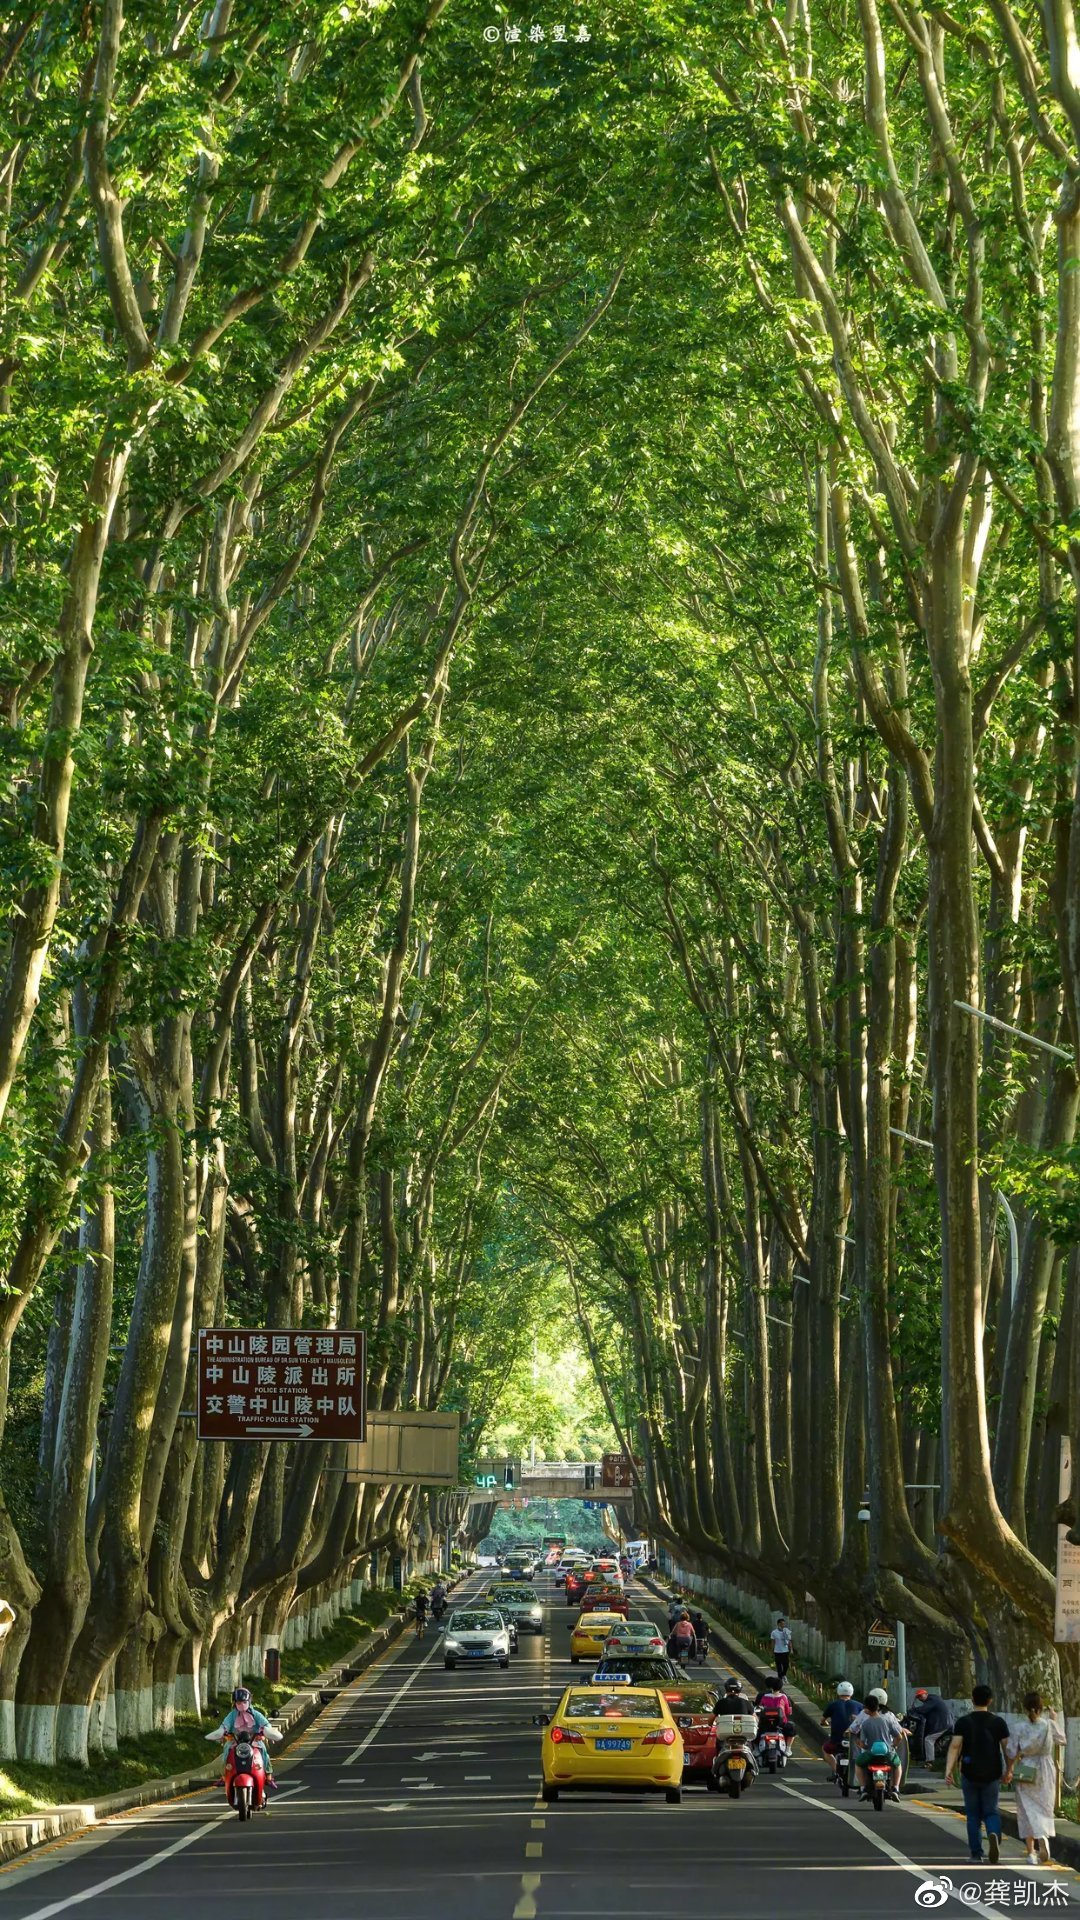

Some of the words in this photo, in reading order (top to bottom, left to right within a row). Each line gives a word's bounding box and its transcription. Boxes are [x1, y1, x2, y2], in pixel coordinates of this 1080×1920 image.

[206, 1334, 357, 1356] 中山陵园管理局
[206, 1364, 356, 1386] 中山陵派出所
[205, 1394, 357, 1416] 交警中山陵中队
